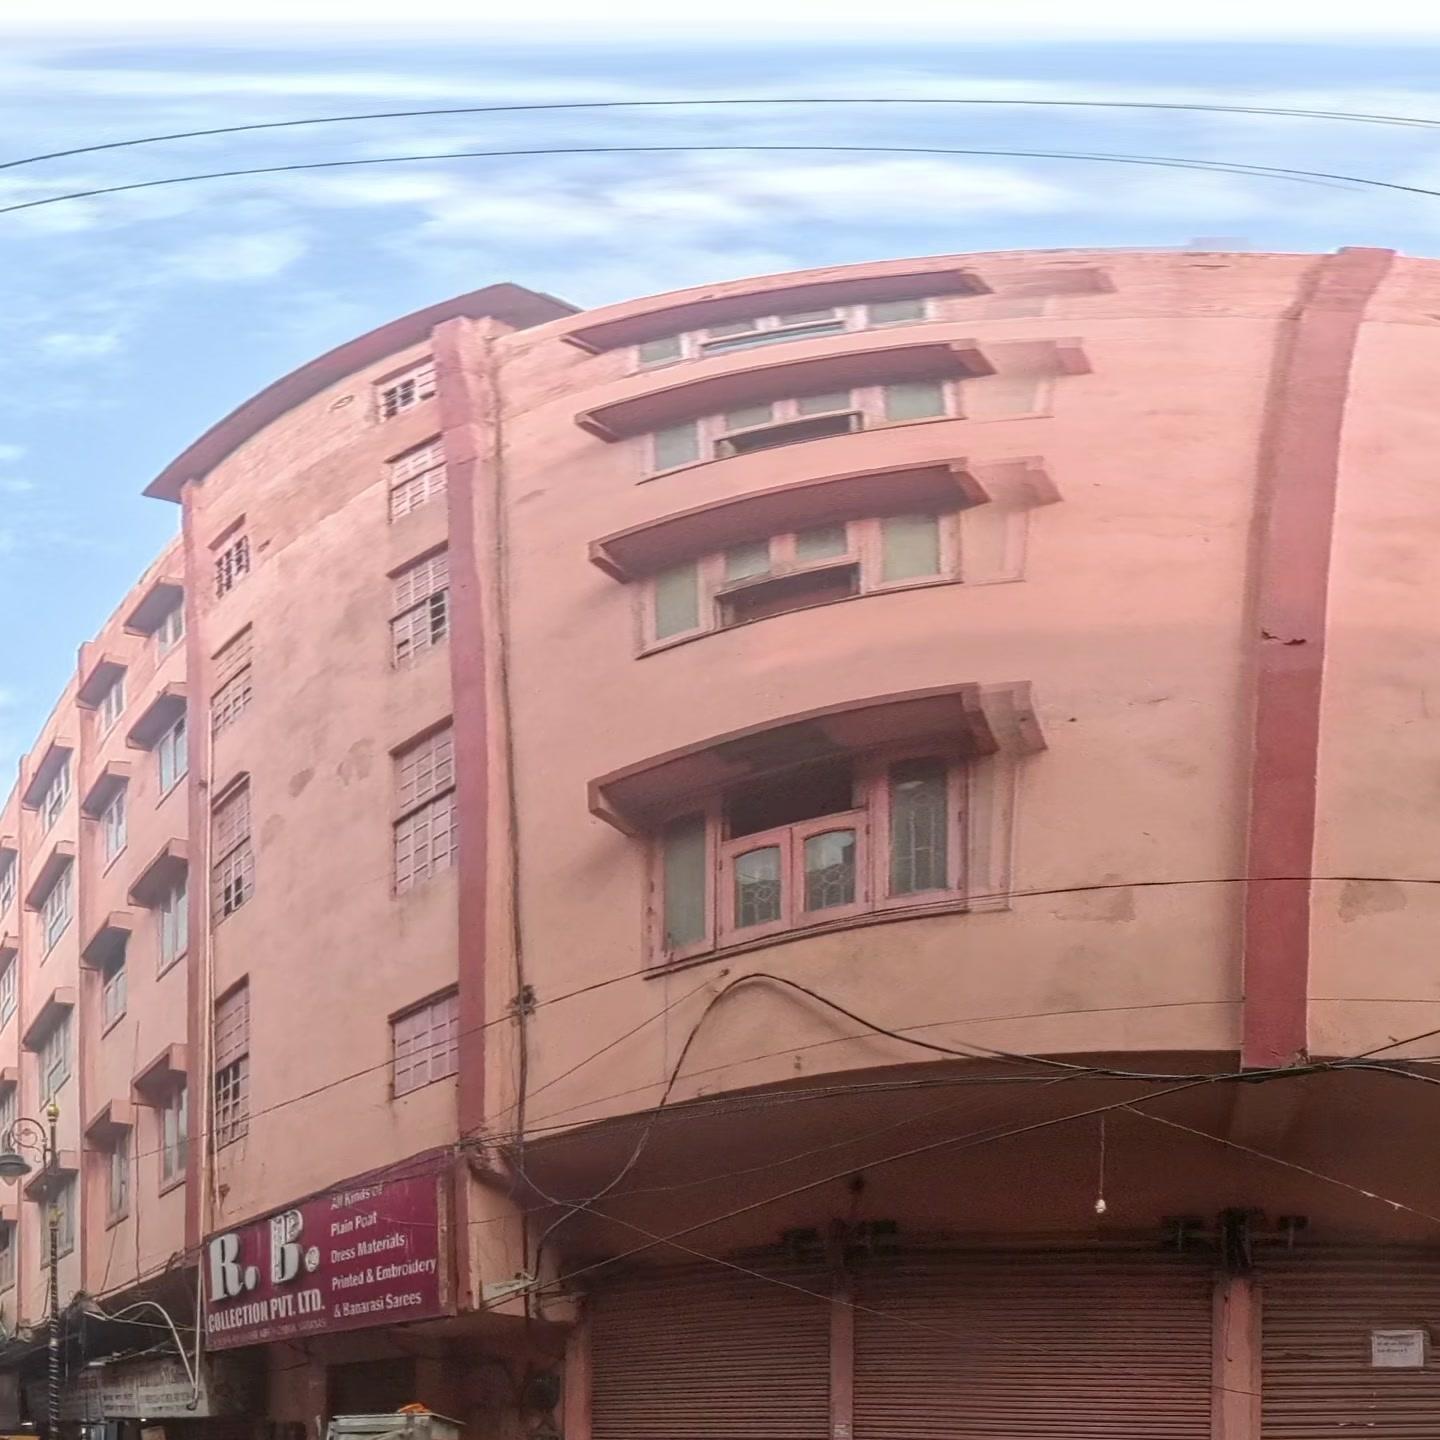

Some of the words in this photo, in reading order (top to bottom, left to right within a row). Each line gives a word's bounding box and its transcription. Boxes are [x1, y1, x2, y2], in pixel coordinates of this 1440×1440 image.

[331, 1219, 353, 1237] Plain
[331, 1247, 356, 1264] Dress
[358, 1232, 405, 1257] Materials
[209, 1233, 260, 1302] R.
[332, 1272, 364, 1291] Printed
[366, 1268, 374, 1283] &
[376, 1258, 437, 1281] Embroidery
[208, 1300, 268, 1333] COLLECTION
[270, 1295, 296, 1320] PVT.
[298, 1289, 325, 1314] LTD.
[334, 1304, 342, 1318] &
[343, 1295, 384, 1317] Banarasi
[386, 1291, 422, 1310] Sarees
